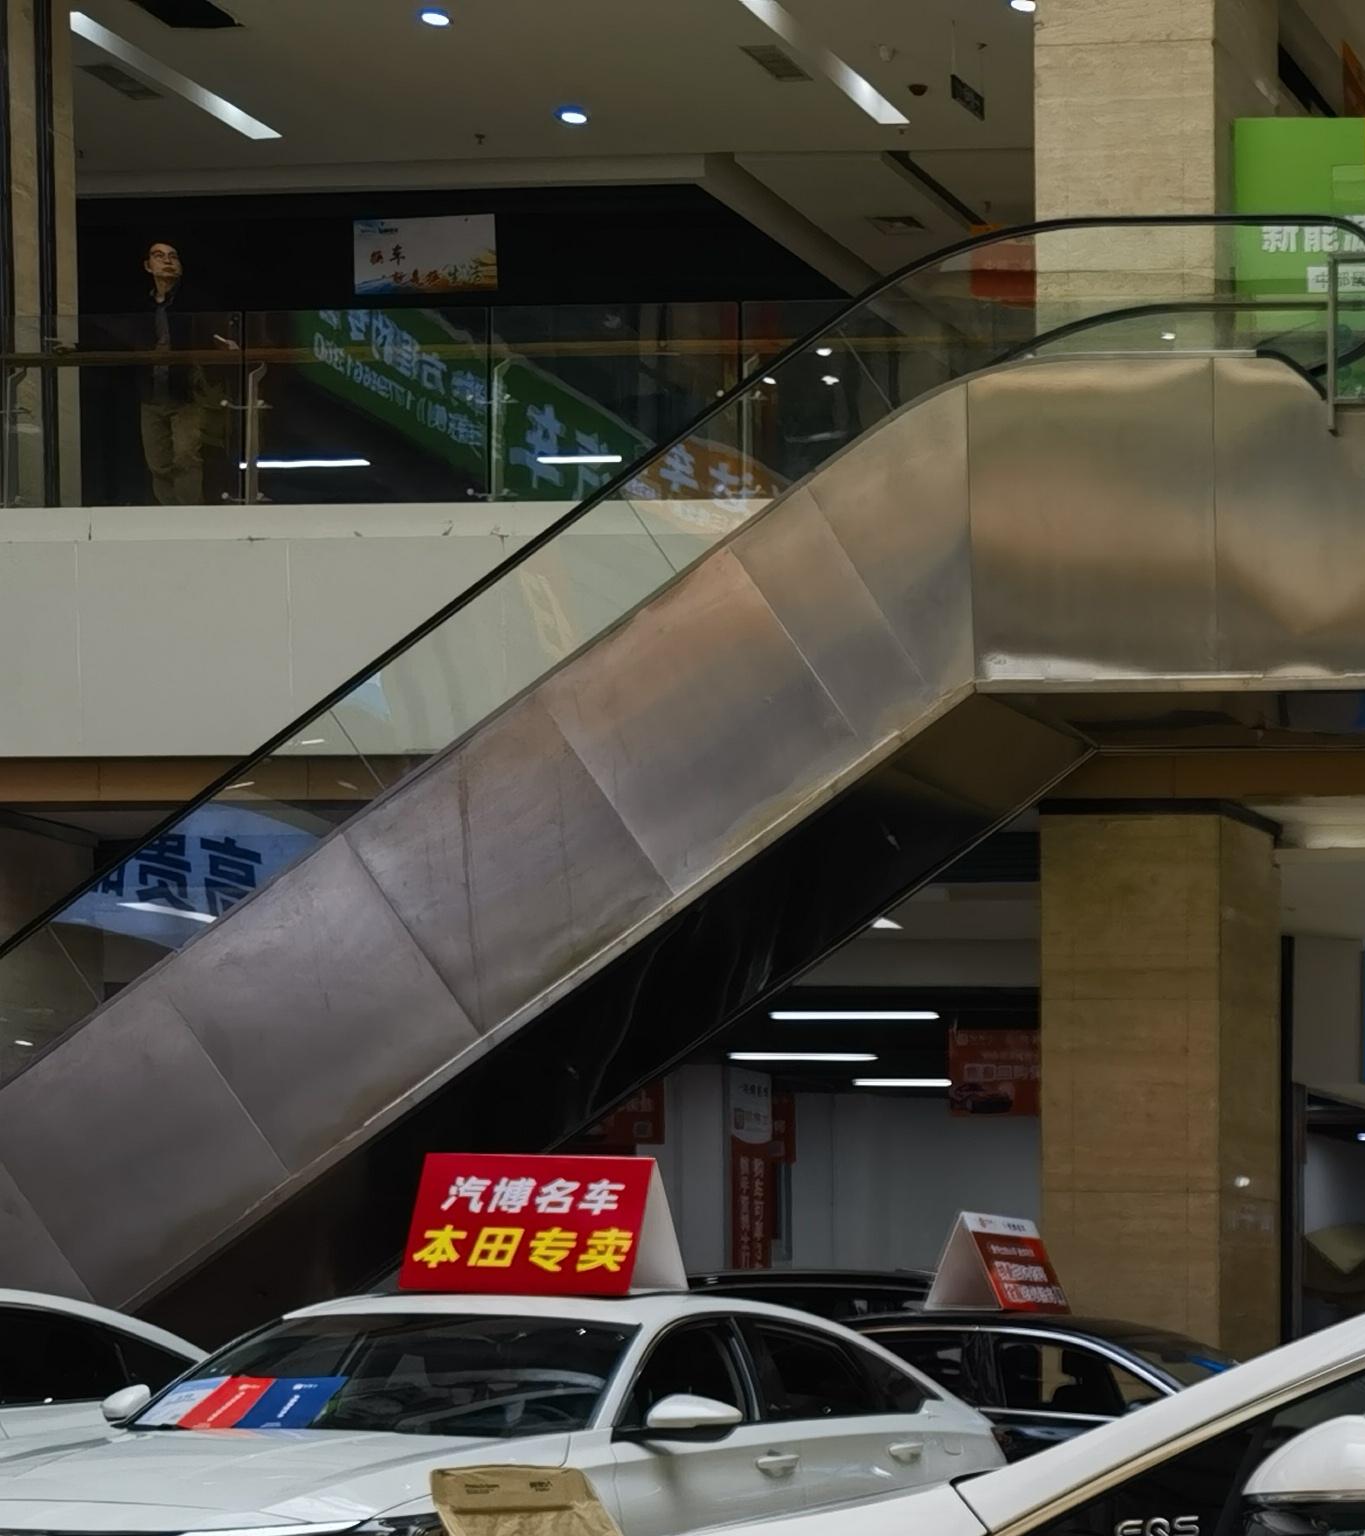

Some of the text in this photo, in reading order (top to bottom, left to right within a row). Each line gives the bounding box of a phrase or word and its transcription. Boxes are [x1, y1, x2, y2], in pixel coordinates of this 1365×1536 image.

[441, 1176, 625, 1216] 汽博名车
[412, 1224, 633, 1273] 本田专卖
